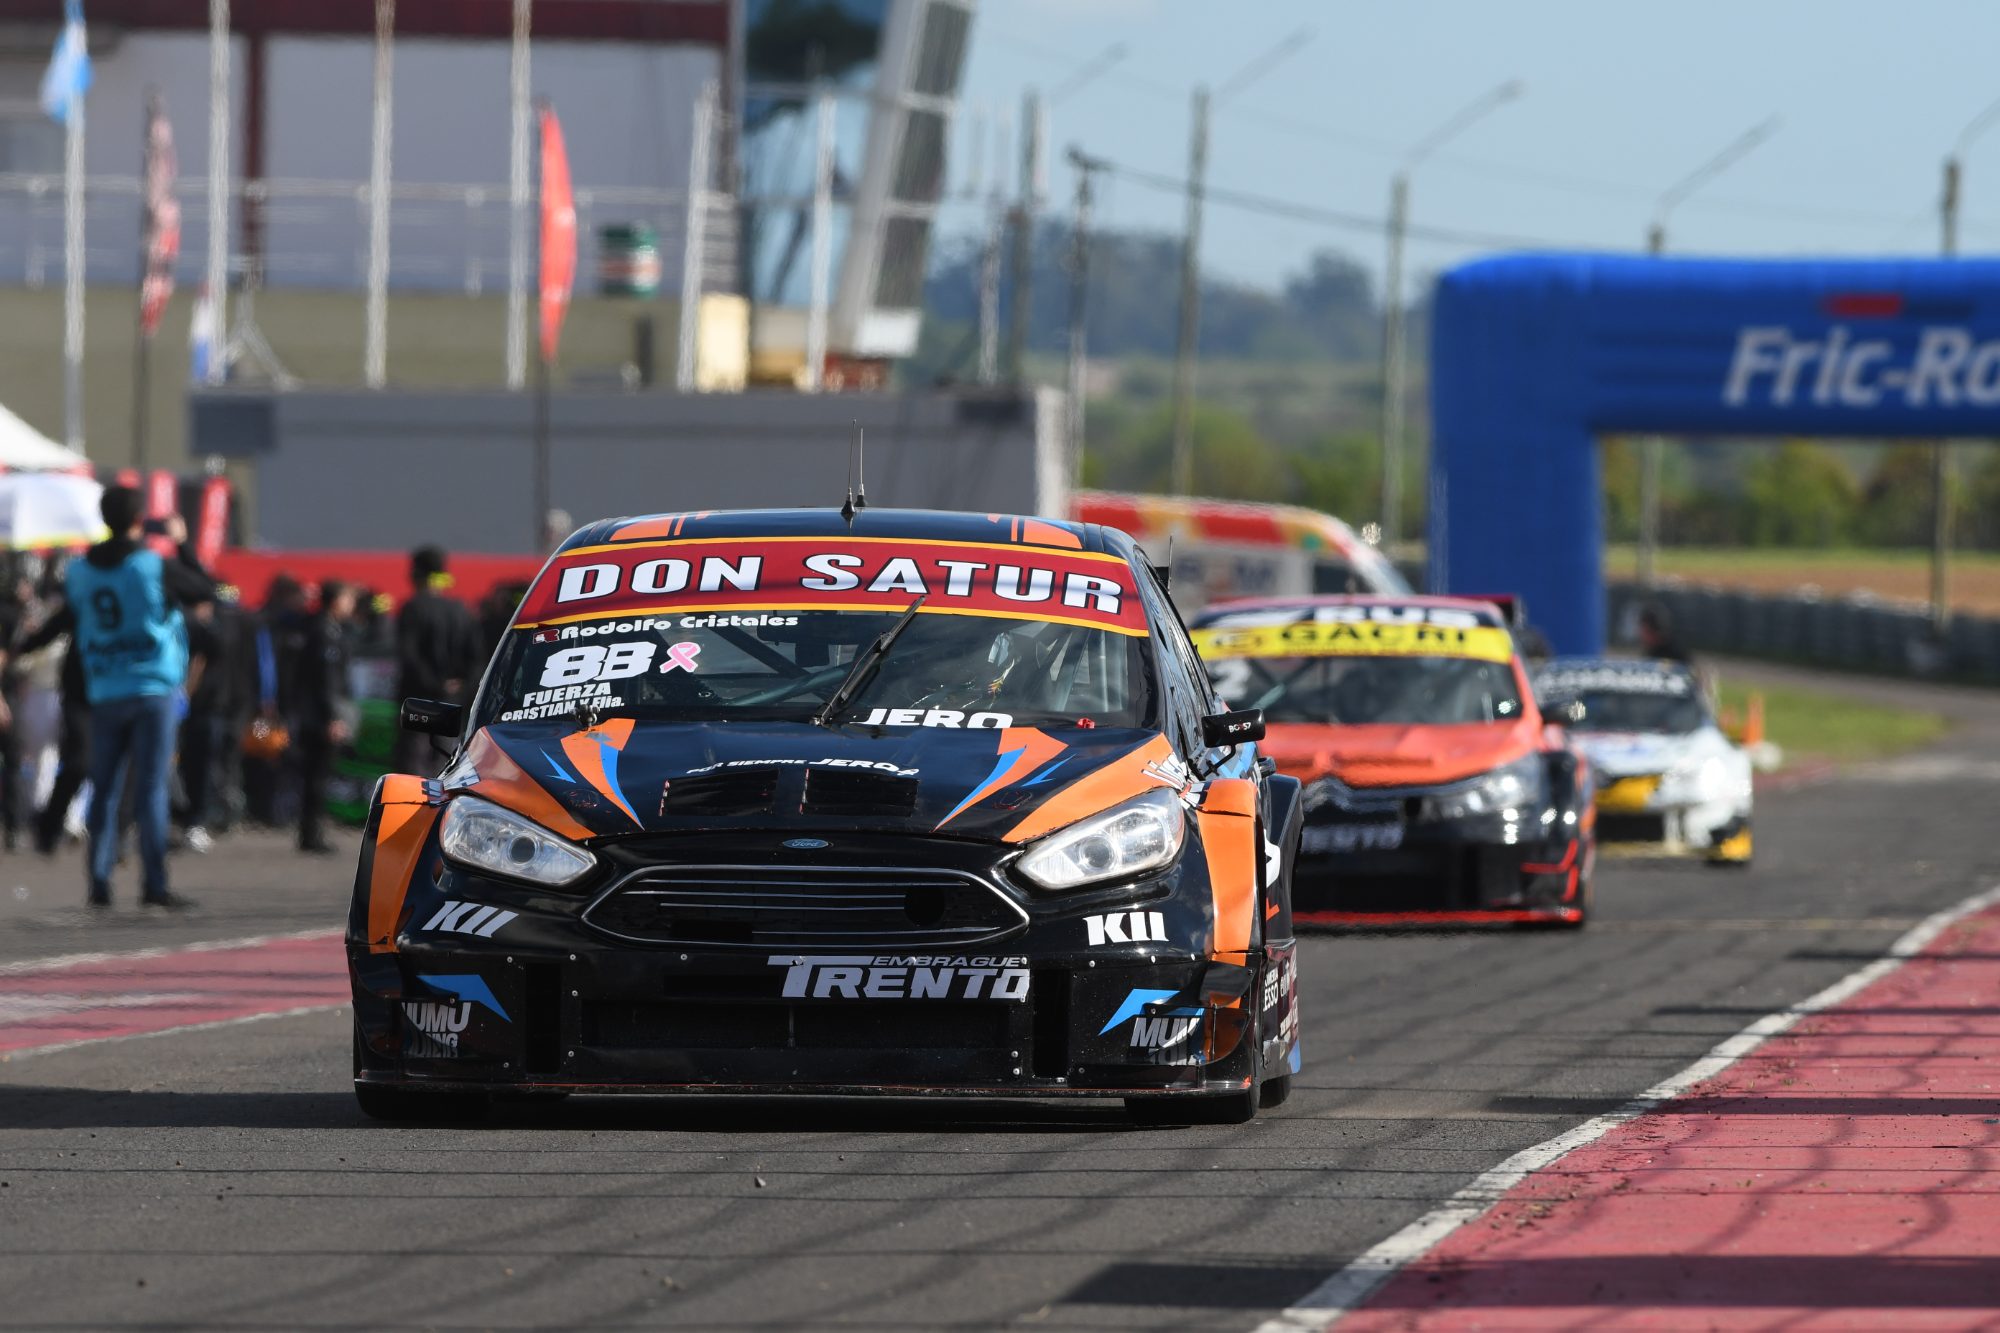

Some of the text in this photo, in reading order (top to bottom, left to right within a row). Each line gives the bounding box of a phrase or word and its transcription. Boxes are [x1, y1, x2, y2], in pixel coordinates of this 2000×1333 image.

[556, 555, 763, 603] DON
[801, 553, 1122, 615] SATUR
[93, 587, 123, 631] 9
[561, 614, 799, 640] Rodolfo Cristales
[539, 641, 657, 688] 88
[523, 682, 611, 708] FUERZA
[501, 700, 577, 722] CRISTIAN
[849, 708, 1014, 729] JERO
[726, 759, 808, 768] SIEMPRE
[808, 758, 900, 773] JERO
[767, 955, 1030, 999] TRENTO
